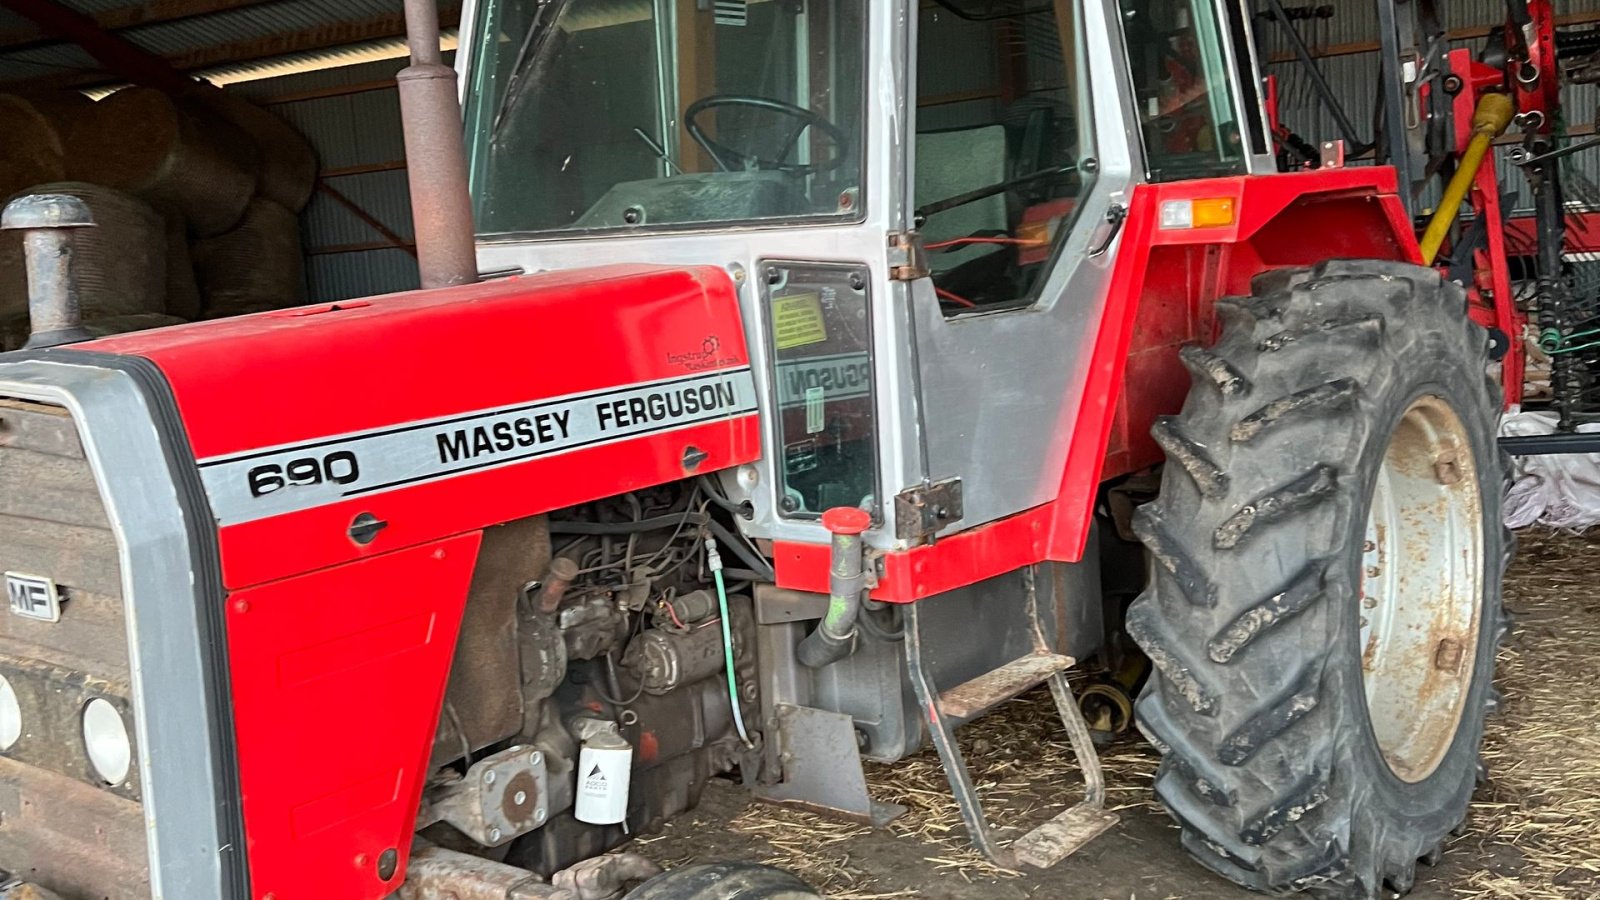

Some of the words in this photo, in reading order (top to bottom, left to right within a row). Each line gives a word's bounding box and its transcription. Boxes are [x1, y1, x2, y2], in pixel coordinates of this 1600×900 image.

[248, 450, 360, 498] 690
[436, 411, 571, 464] MASSEY
[596, 381, 736, 431] FERGUSON
[9, 582, 47, 612] MF
